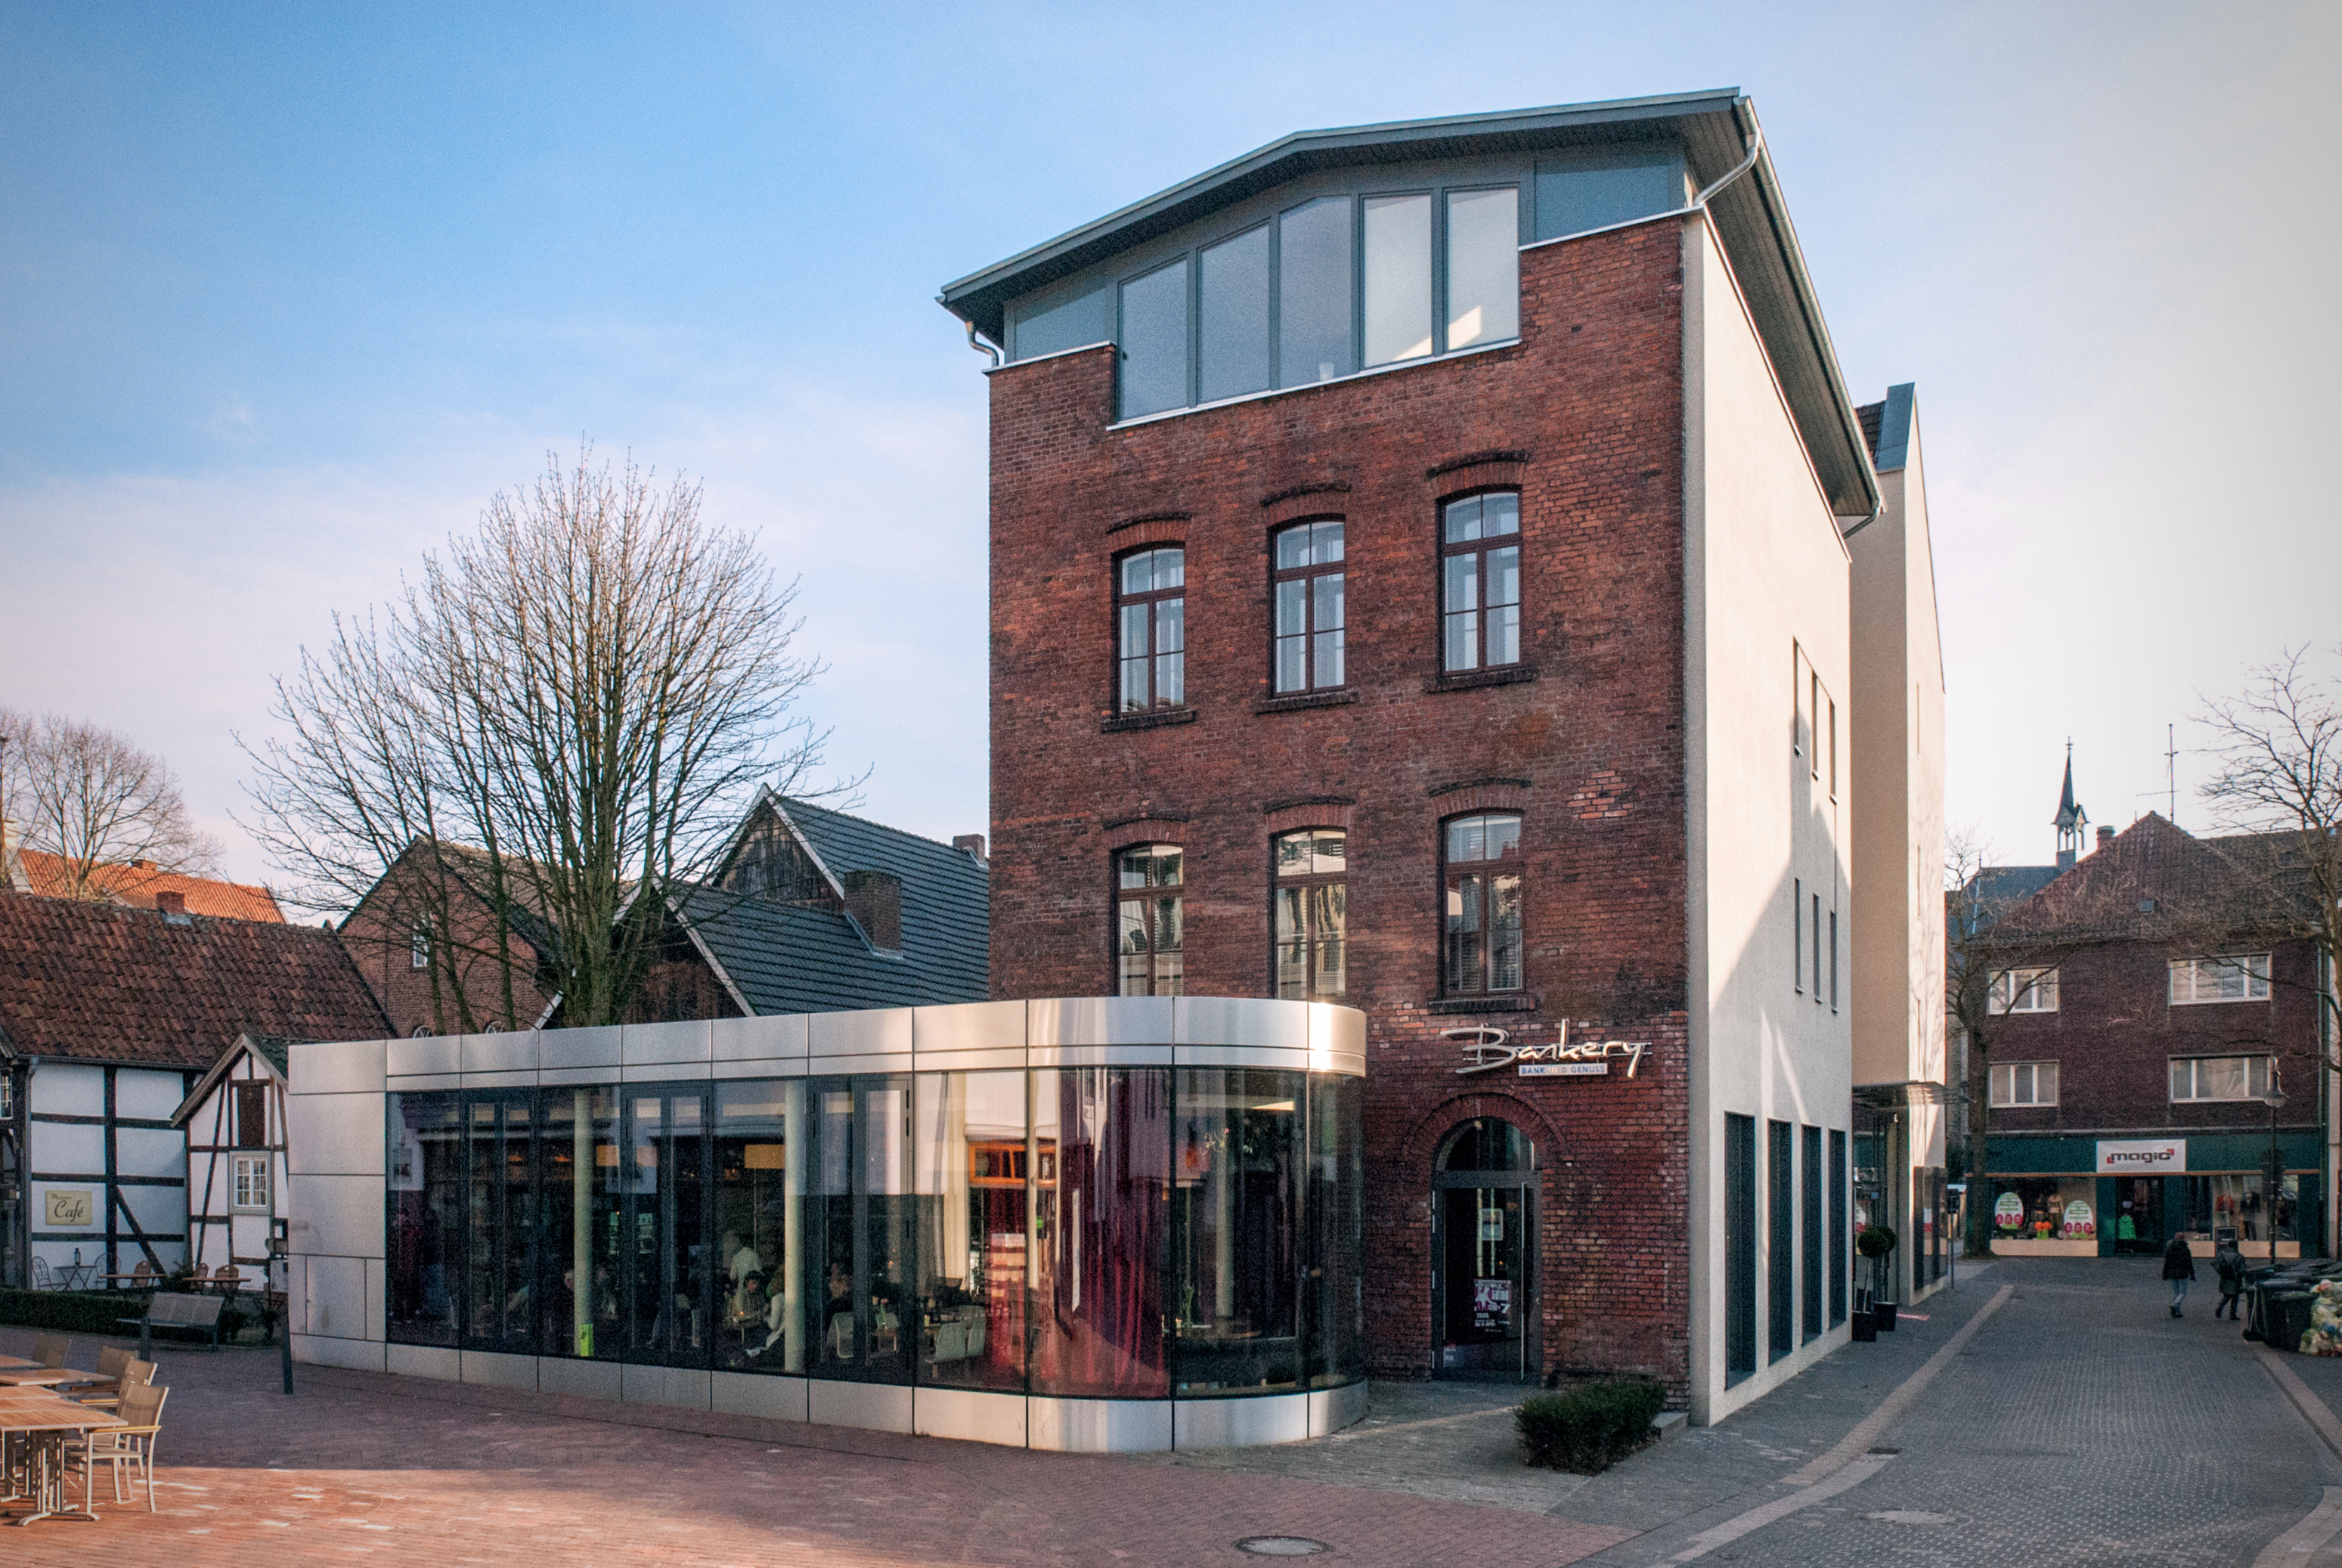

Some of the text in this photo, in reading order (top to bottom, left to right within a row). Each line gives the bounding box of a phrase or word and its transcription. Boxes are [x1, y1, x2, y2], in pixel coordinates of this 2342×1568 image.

[1440, 1018, 1643, 1078] Bankery
[2111, 1152, 2171, 1163] magic
[54, 1199, 84, 1222] Café
